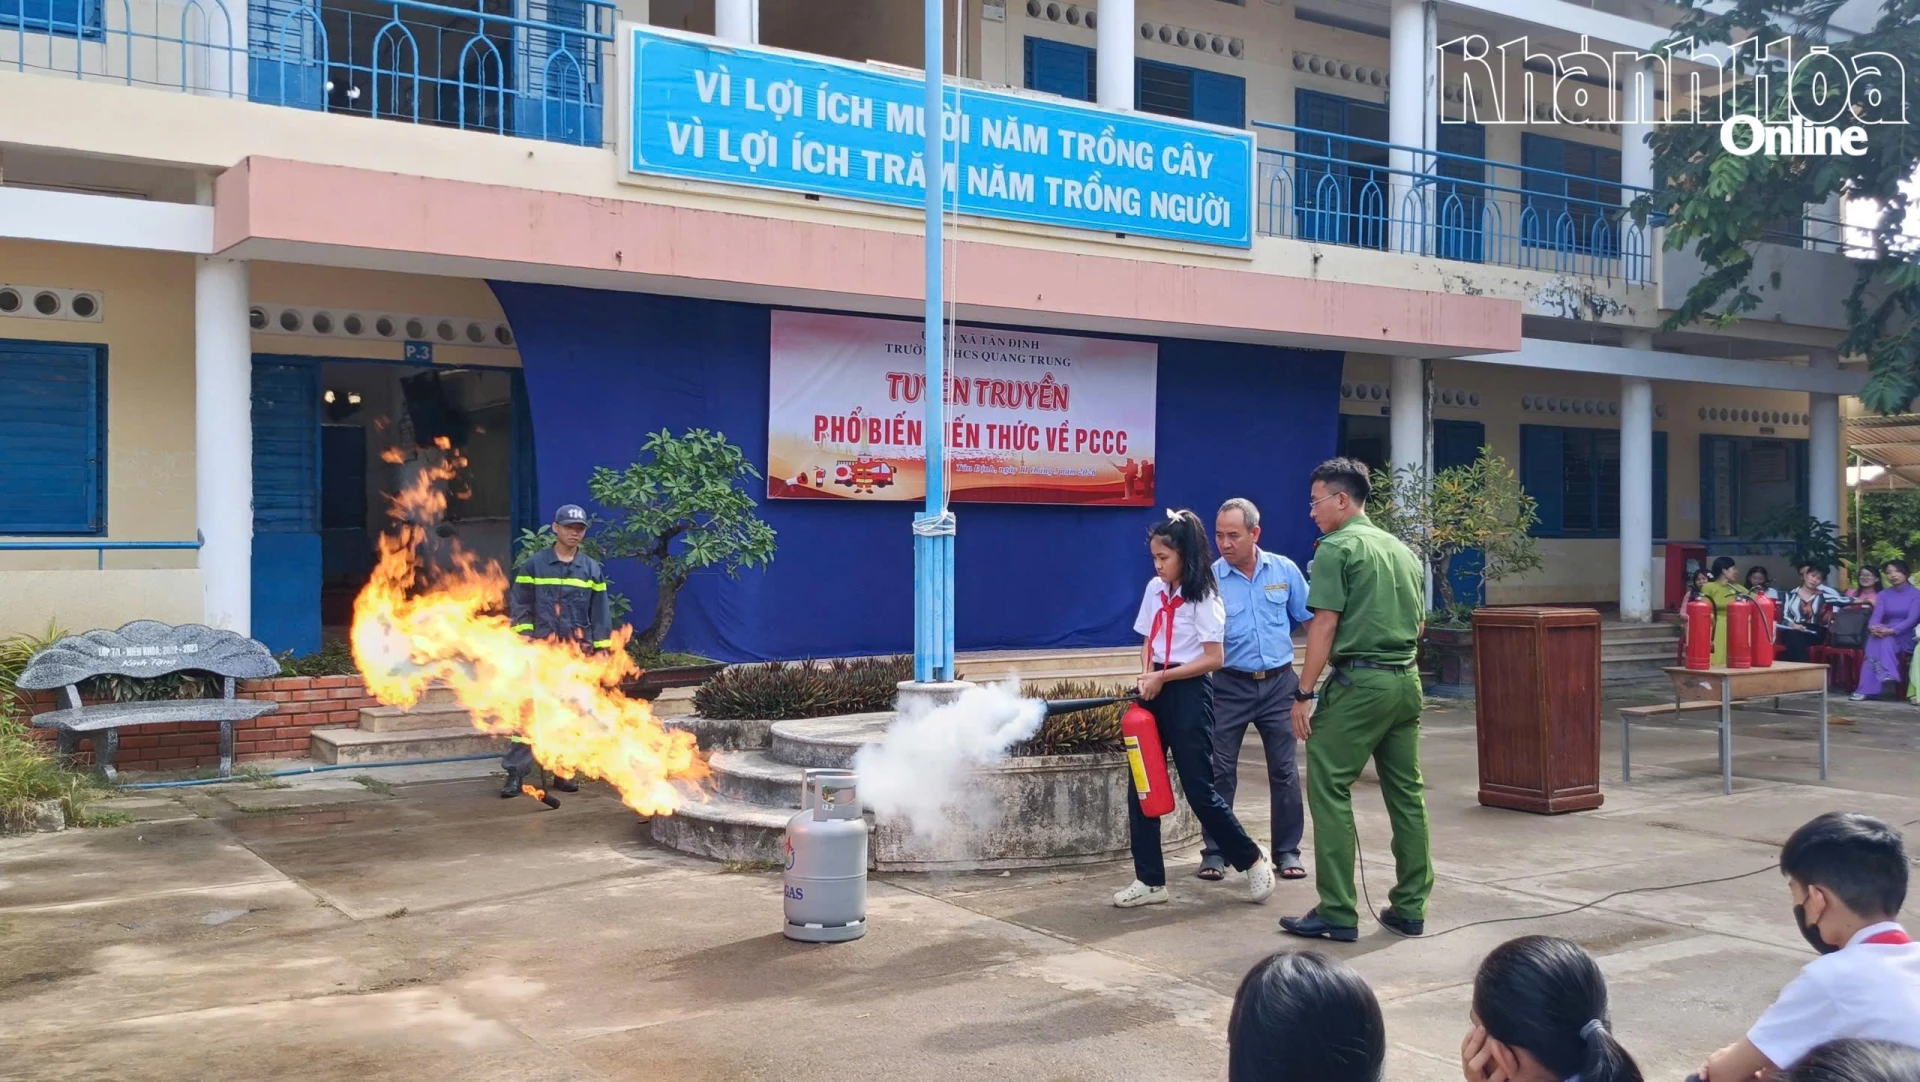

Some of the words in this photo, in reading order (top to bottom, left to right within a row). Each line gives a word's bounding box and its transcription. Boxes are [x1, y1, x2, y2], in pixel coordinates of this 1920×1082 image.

[694, 64, 731, 107] VÌ
[745, 78, 803, 122] LỢI
[817, 82, 873, 129] ÍCH
[982, 115, 1048, 156] NĂM
[1058, 125, 1154, 171] TRỒNG
[1162, 141, 1214, 180] CÂY
[667, 116, 704, 158] VÌ
[719, 130, 778, 172] LỢI
[792, 132, 849, 178] ÍCH
[968, 163, 1035, 204] NĂM
[1044, 170, 1141, 217] TRỒNG
[1151, 191, 1231, 228] NGƯỜI
[960, 333, 977, 345] XÃ
[980, 334, 1005, 347] TÂN
[1008, 338, 1040, 351] ĐỊNH
[406, 345, 430, 360] P.3
[981, 351, 1026, 364] QUANG
[1030, 355, 1072, 367] TRUNG
[974, 371, 1070, 412] TRUYỀN
[814, 406, 862, 444] PHỔ
[868, 411, 922, 446] BIẾN
[943, 414, 980, 449] IẾN
[986, 420, 1040, 451] THỨC
[1046, 420, 1069, 452] VỀ
[1075, 429, 1128, 455] PCCC
[567, 508, 584, 519] 114
[784, 885, 803, 900] GAS
